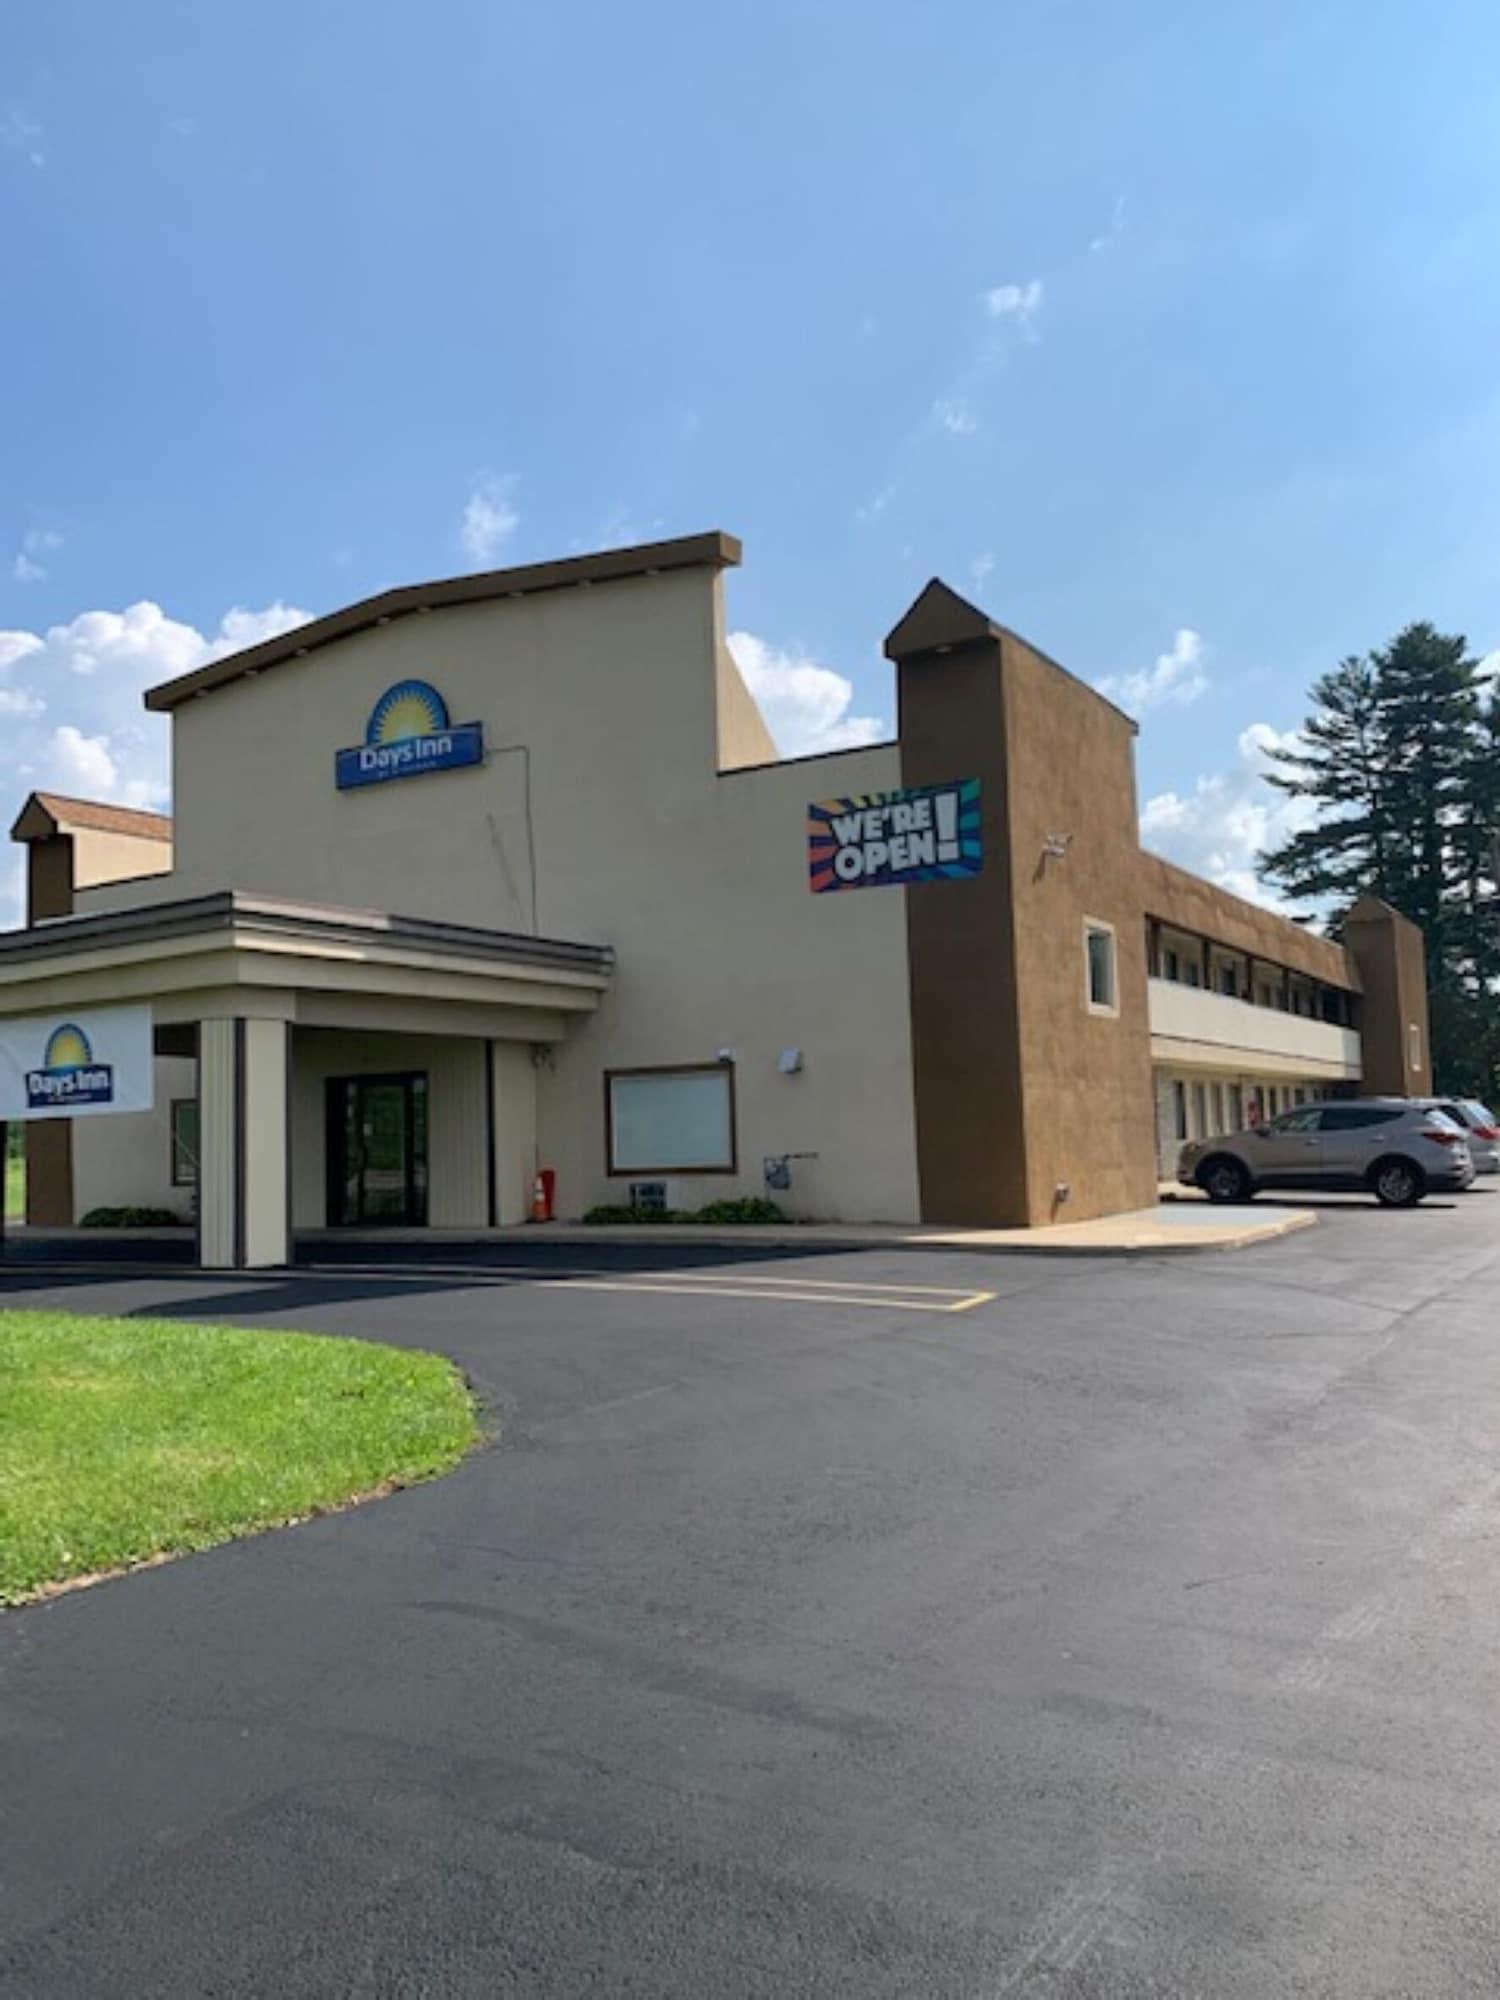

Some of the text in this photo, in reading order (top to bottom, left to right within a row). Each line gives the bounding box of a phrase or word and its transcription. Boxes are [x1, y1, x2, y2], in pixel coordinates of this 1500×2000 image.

[360, 745, 413, 770] Days
[416, 737, 453, 759] Inn
[830, 797, 933, 846] WE'RE
[28, 1069, 109, 1096] Days Inn
